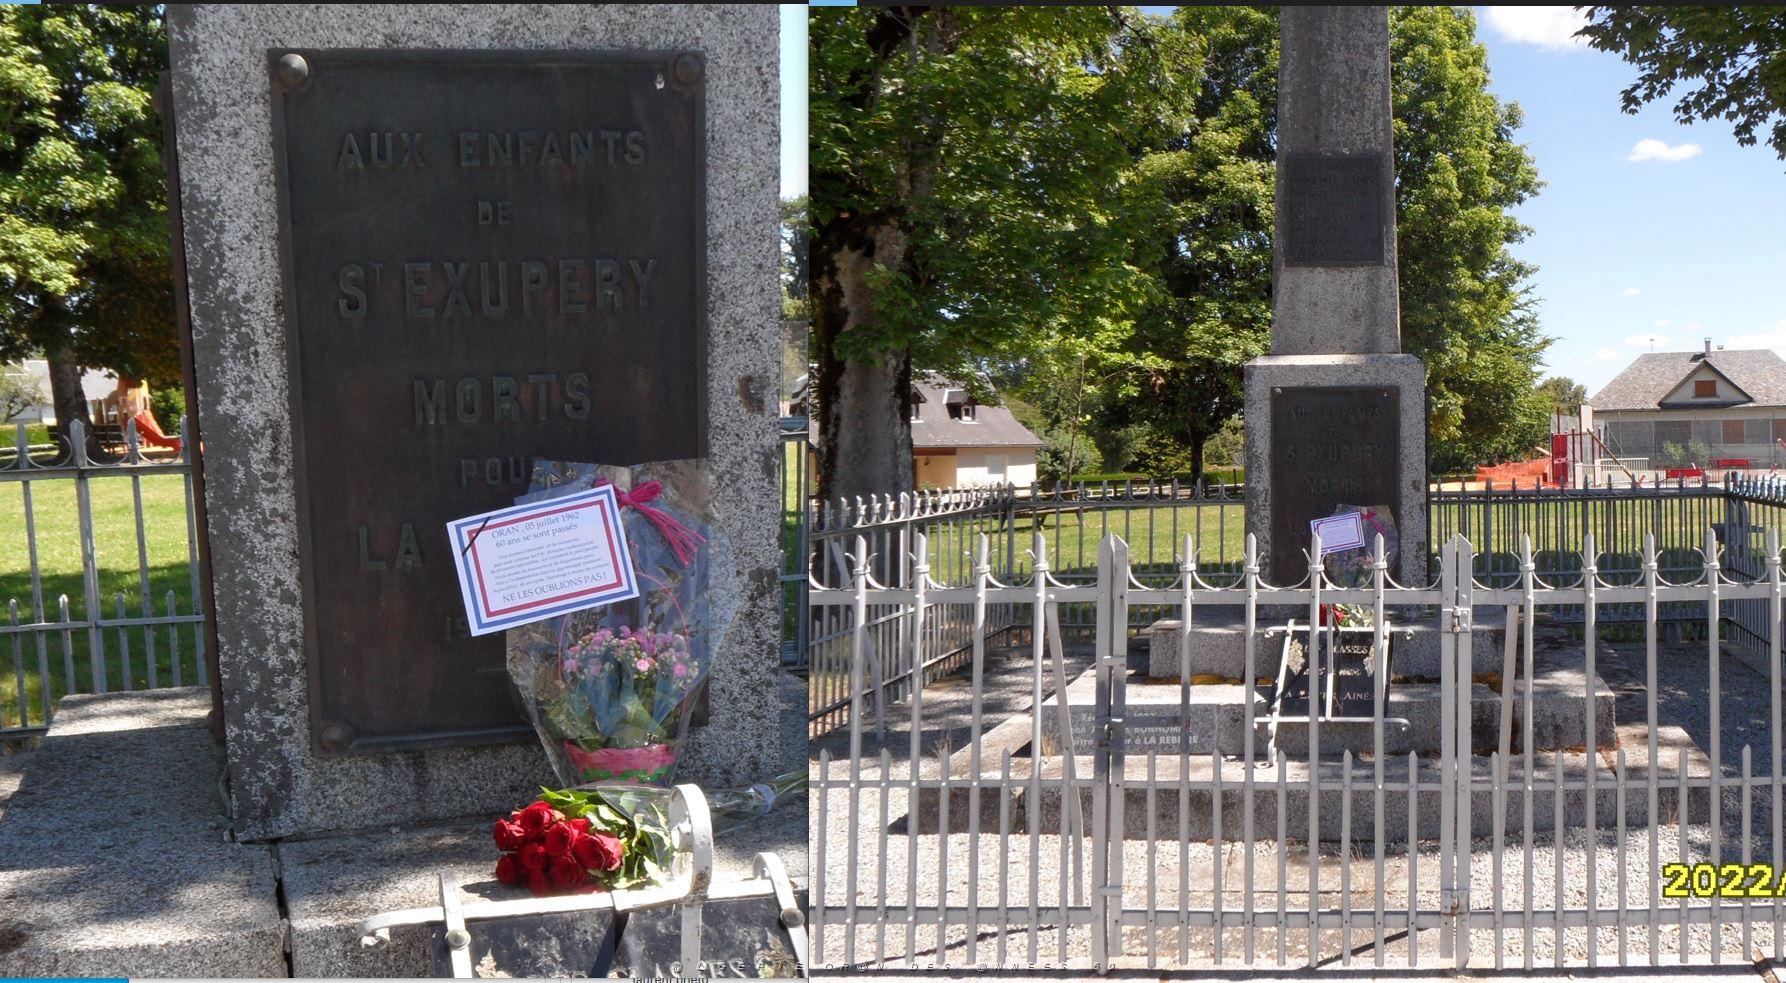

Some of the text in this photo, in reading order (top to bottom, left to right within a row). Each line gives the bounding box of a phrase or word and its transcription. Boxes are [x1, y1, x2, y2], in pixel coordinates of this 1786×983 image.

[338, 129, 647, 169] AUX ENFANTS
[478, 201, 511, 226] DE
[404, 258, 659, 318] EXUPERY
[414, 373, 591, 425] MORTS
[461, 457, 526, 488] POU
[491, 525, 520, 539] ORAN
[524, 521, 535, 531] 05
[536, 516, 560, 529] juillet
[562, 510, 581, 521] 1962
[496, 540, 506, 548] 60
[507, 537, 521, 545] ans
[533, 529, 551, 538] sont
[552, 523, 578, 536] passés
[358, 522, 423, 570] LA
[502, 592, 516, 603] NE
[517, 589, 534, 599] LES
[534, 577, 583, 595] OUBLIONS
[584, 572, 603, 583] PAS
